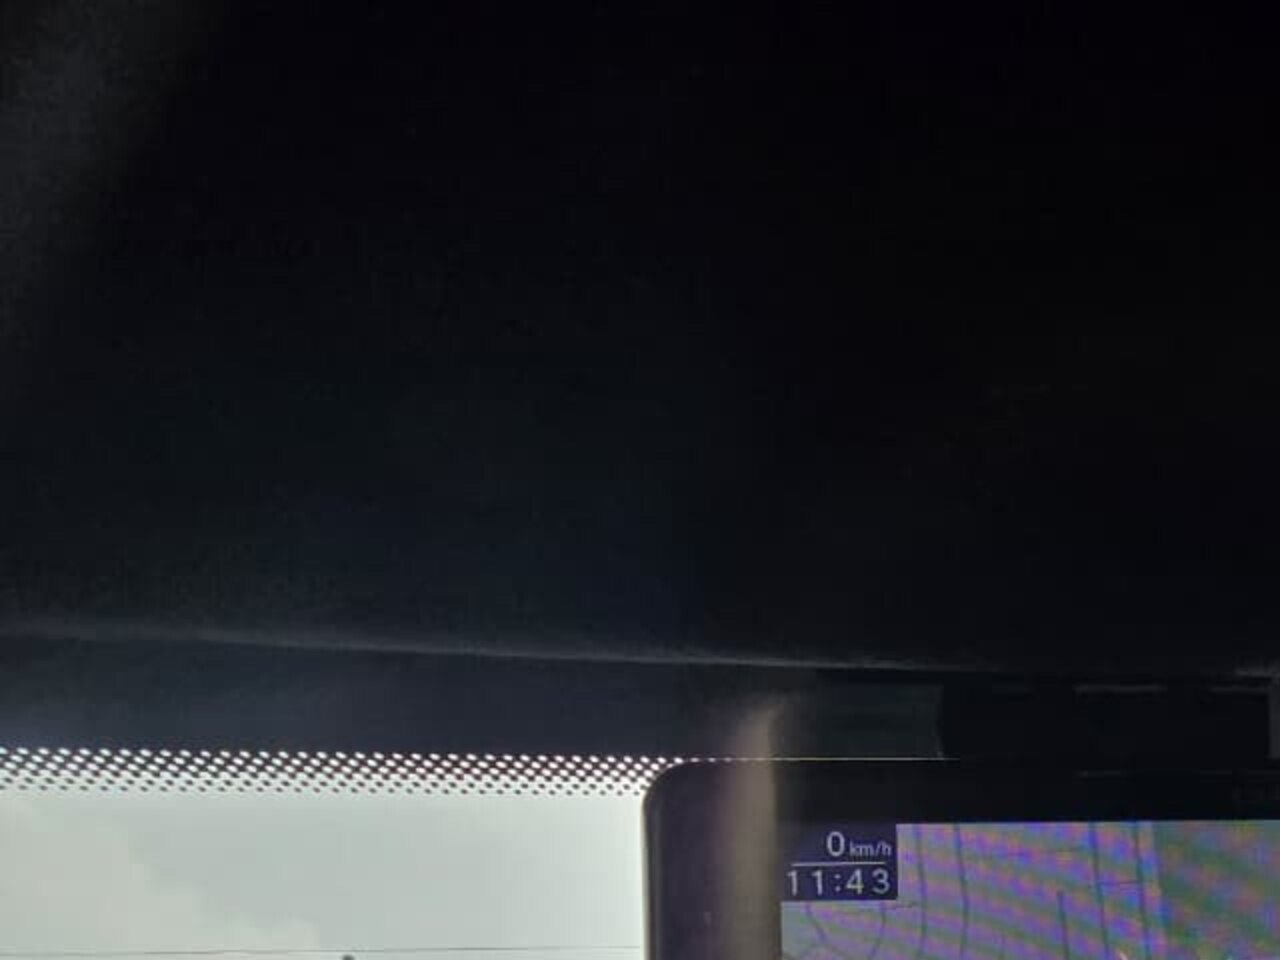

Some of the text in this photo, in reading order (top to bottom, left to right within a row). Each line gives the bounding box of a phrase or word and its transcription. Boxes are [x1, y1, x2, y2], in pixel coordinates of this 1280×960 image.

[826, 831, 892, 857] 0 km/h
[786, 868, 891, 896] 11:43
